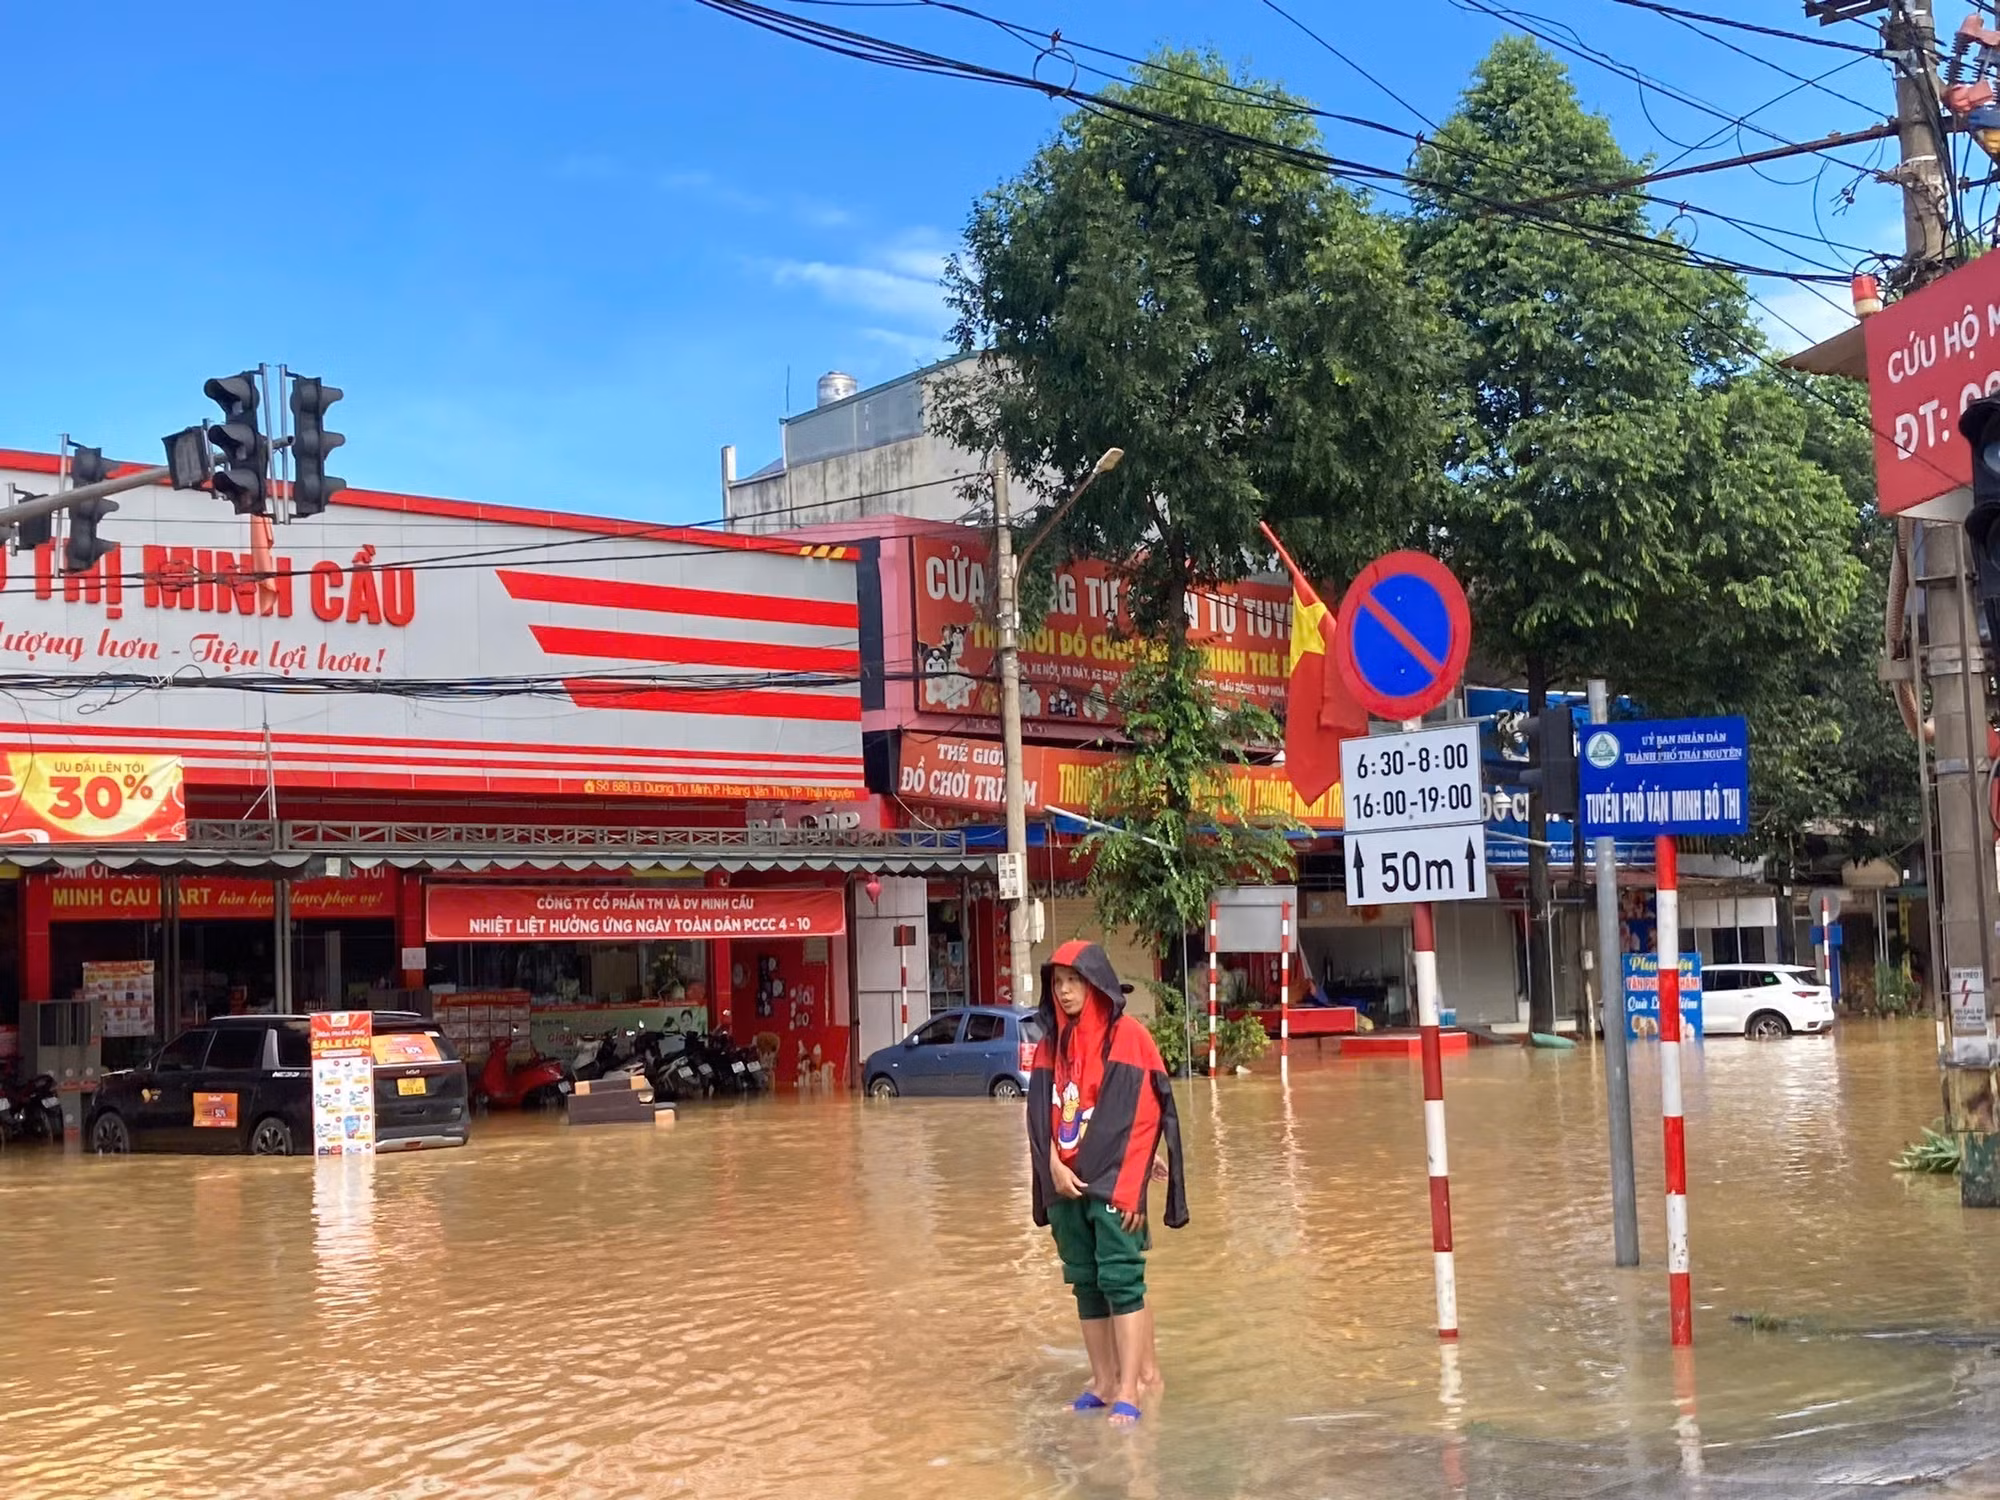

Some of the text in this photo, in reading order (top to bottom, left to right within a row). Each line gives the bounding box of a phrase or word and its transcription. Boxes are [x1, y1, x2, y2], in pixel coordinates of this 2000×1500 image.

[1888, 331, 1936, 383] CỨU
[1943, 304, 1980, 360] HỘ
[1894, 399, 1950, 461] ĐT:
[143, 544, 293, 618] MINH
[310, 544, 415, 627] CẦU
[926, 546, 985, 604] CỬA
[1205, 592, 1239, 642] TỰ
[1243, 598, 1292, 640] TUY
[97, 628, 160, 660] hơn
[189, 633, 259, 673] Tiện
[269, 640, 308, 676] lợi
[317, 642, 386, 673] hơn!
[1624, 750, 1657, 762] THÀNH
[1658, 748, 1677, 761] PHỐ
[1677, 747, 1701, 760] THÁI
[1702, 745, 1742, 759] NGUYÊN
[1656, 735, 1676, 745] BAN
[1677, 731, 1704, 744] NHÂN
[1706, 729, 1726, 743] DÂN
[54, 762, 72, 772] ƯU
[99, 759, 122, 773] LÊN
[125, 761, 145, 773] TỚI
[901, 755, 925, 793] ĐỒ
[929, 769, 971, 800] CHƠI
[1357, 743, 1468, 778] 6:30-8:00
[48, 774, 153, 820] 30%
[1354, 783, 1472, 819] 16:00-19:00
[1586, 782, 1620, 825] TUYẾN
[1623, 779, 1645, 823] PHỐ
[1646, 784, 1669, 823] VĂN
[1672, 790, 1702, 822] MINH
[1704, 782, 1720, 821] ĐÔ
[1722, 788, 1741, 825] THỊ
[1381, 851, 1454, 893] 50m
[53, 888, 103, 906] MINH
[536, 896, 572, 910] CÔNG
[574, 898, 590, 910] TY
[647, 898, 664, 910] TM
[666, 895, 681, 910] VÀ
[683, 898, 699, 910] DV
[701, 898, 729, 910] MINH
[469, 914, 513, 937] NHIỆT
[516, 915, 546, 937] LIỆT
[550, 913, 600, 934] HƯỞNG
[602, 914, 632, 933] ỨNG
[636, 914, 672, 933] NGÀY
[674, 914, 711, 933] TOÀN
[714, 915, 741, 932] DÂN
[744, 917, 776, 932] PCCC
[778, 918, 787, 930] 4
[797, 917, 811, 931] 10
[312, 1039, 343, 1050] SALE
